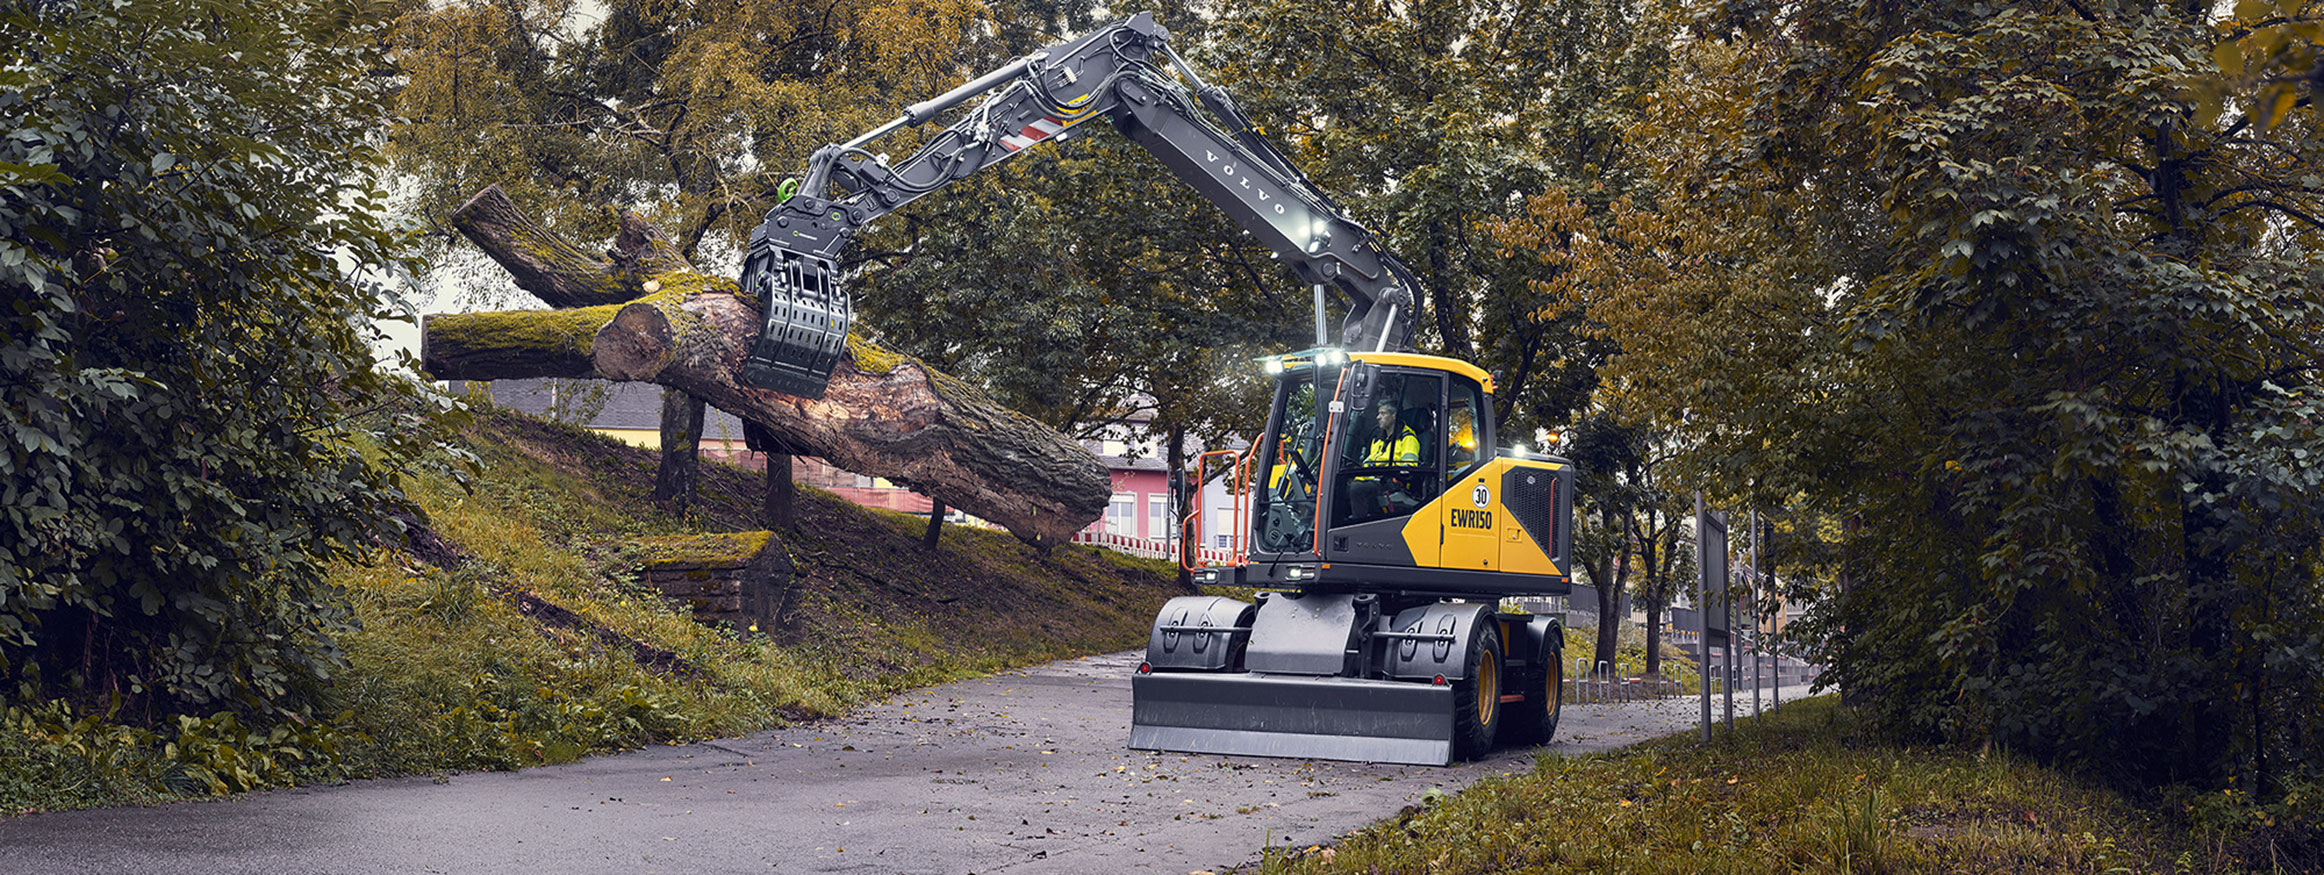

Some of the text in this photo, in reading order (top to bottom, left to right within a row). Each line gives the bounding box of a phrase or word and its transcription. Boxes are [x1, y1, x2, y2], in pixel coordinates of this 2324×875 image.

[1206, 149, 1285, 214] VOLVO
[1475, 488, 1487, 505] 30
[1451, 508, 1492, 530] EWR150
